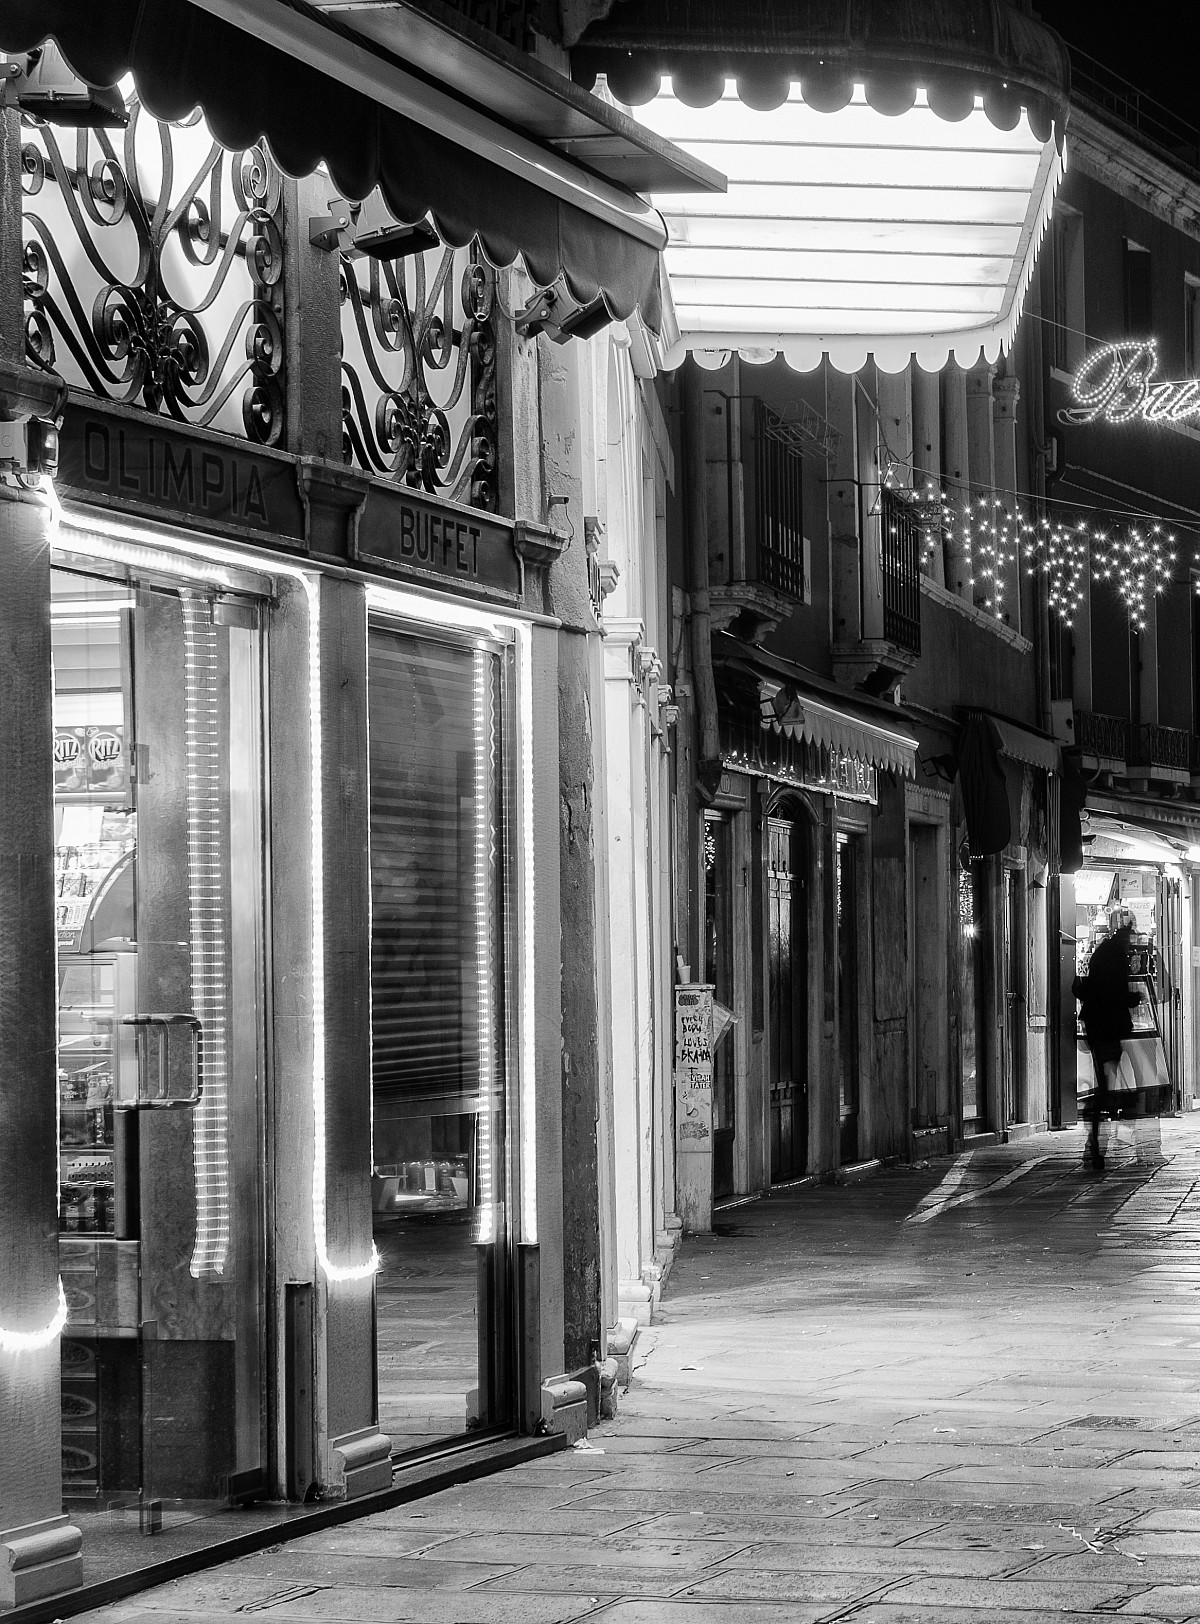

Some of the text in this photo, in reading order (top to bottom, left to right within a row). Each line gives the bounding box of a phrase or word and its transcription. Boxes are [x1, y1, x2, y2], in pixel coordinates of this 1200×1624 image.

[82, 420, 269, 526] OLIMPIA
[399, 505, 483, 577] BUFFET
[91, 738, 121, 761] RITZ
